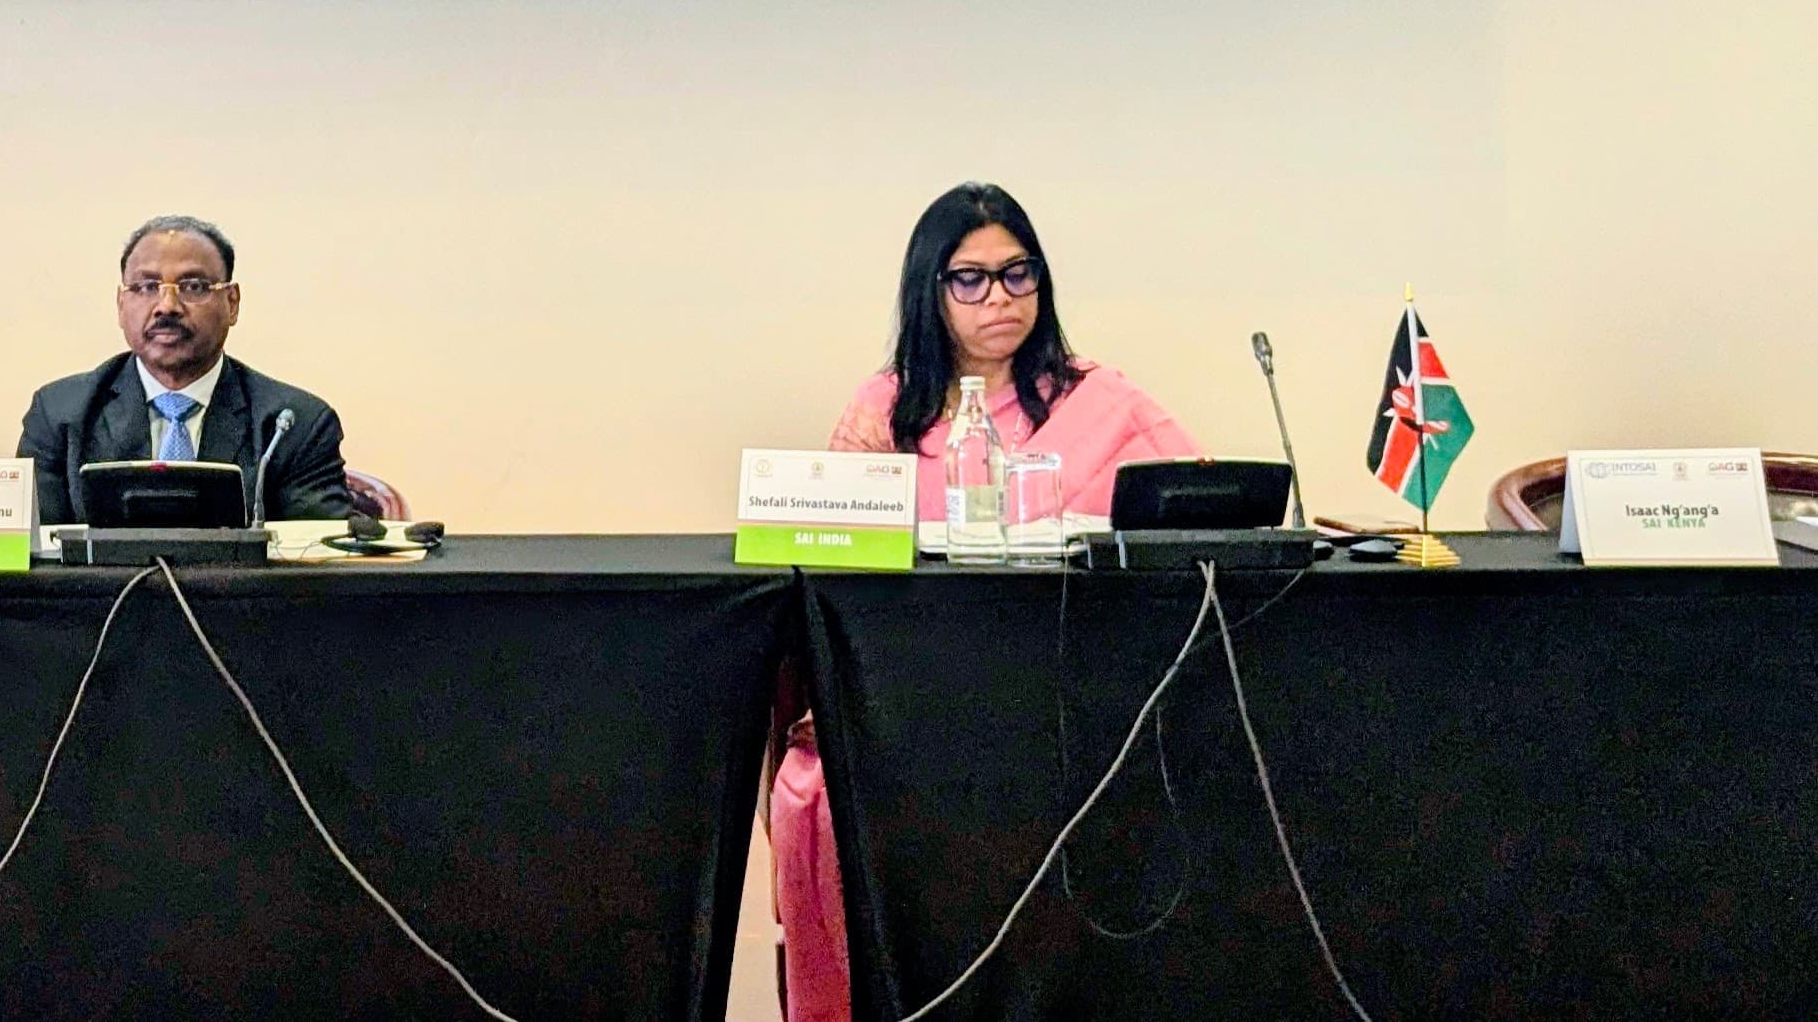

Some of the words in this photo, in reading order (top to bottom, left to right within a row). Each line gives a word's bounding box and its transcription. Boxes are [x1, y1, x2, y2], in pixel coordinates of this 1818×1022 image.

[1611, 461, 1656, 472] INTOSAI
[749, 496, 788, 508] Shefali
[790, 497, 848, 510] Srivastava
[850, 499, 904, 512] Andaleeb
[1625, 504, 1659, 517] Isaac
[1642, 518, 1662, 529] SAI
[1667, 518, 1706, 529] KENYA
[794, 532, 814, 545] SAI
[818, 532, 852, 546] INDIA
